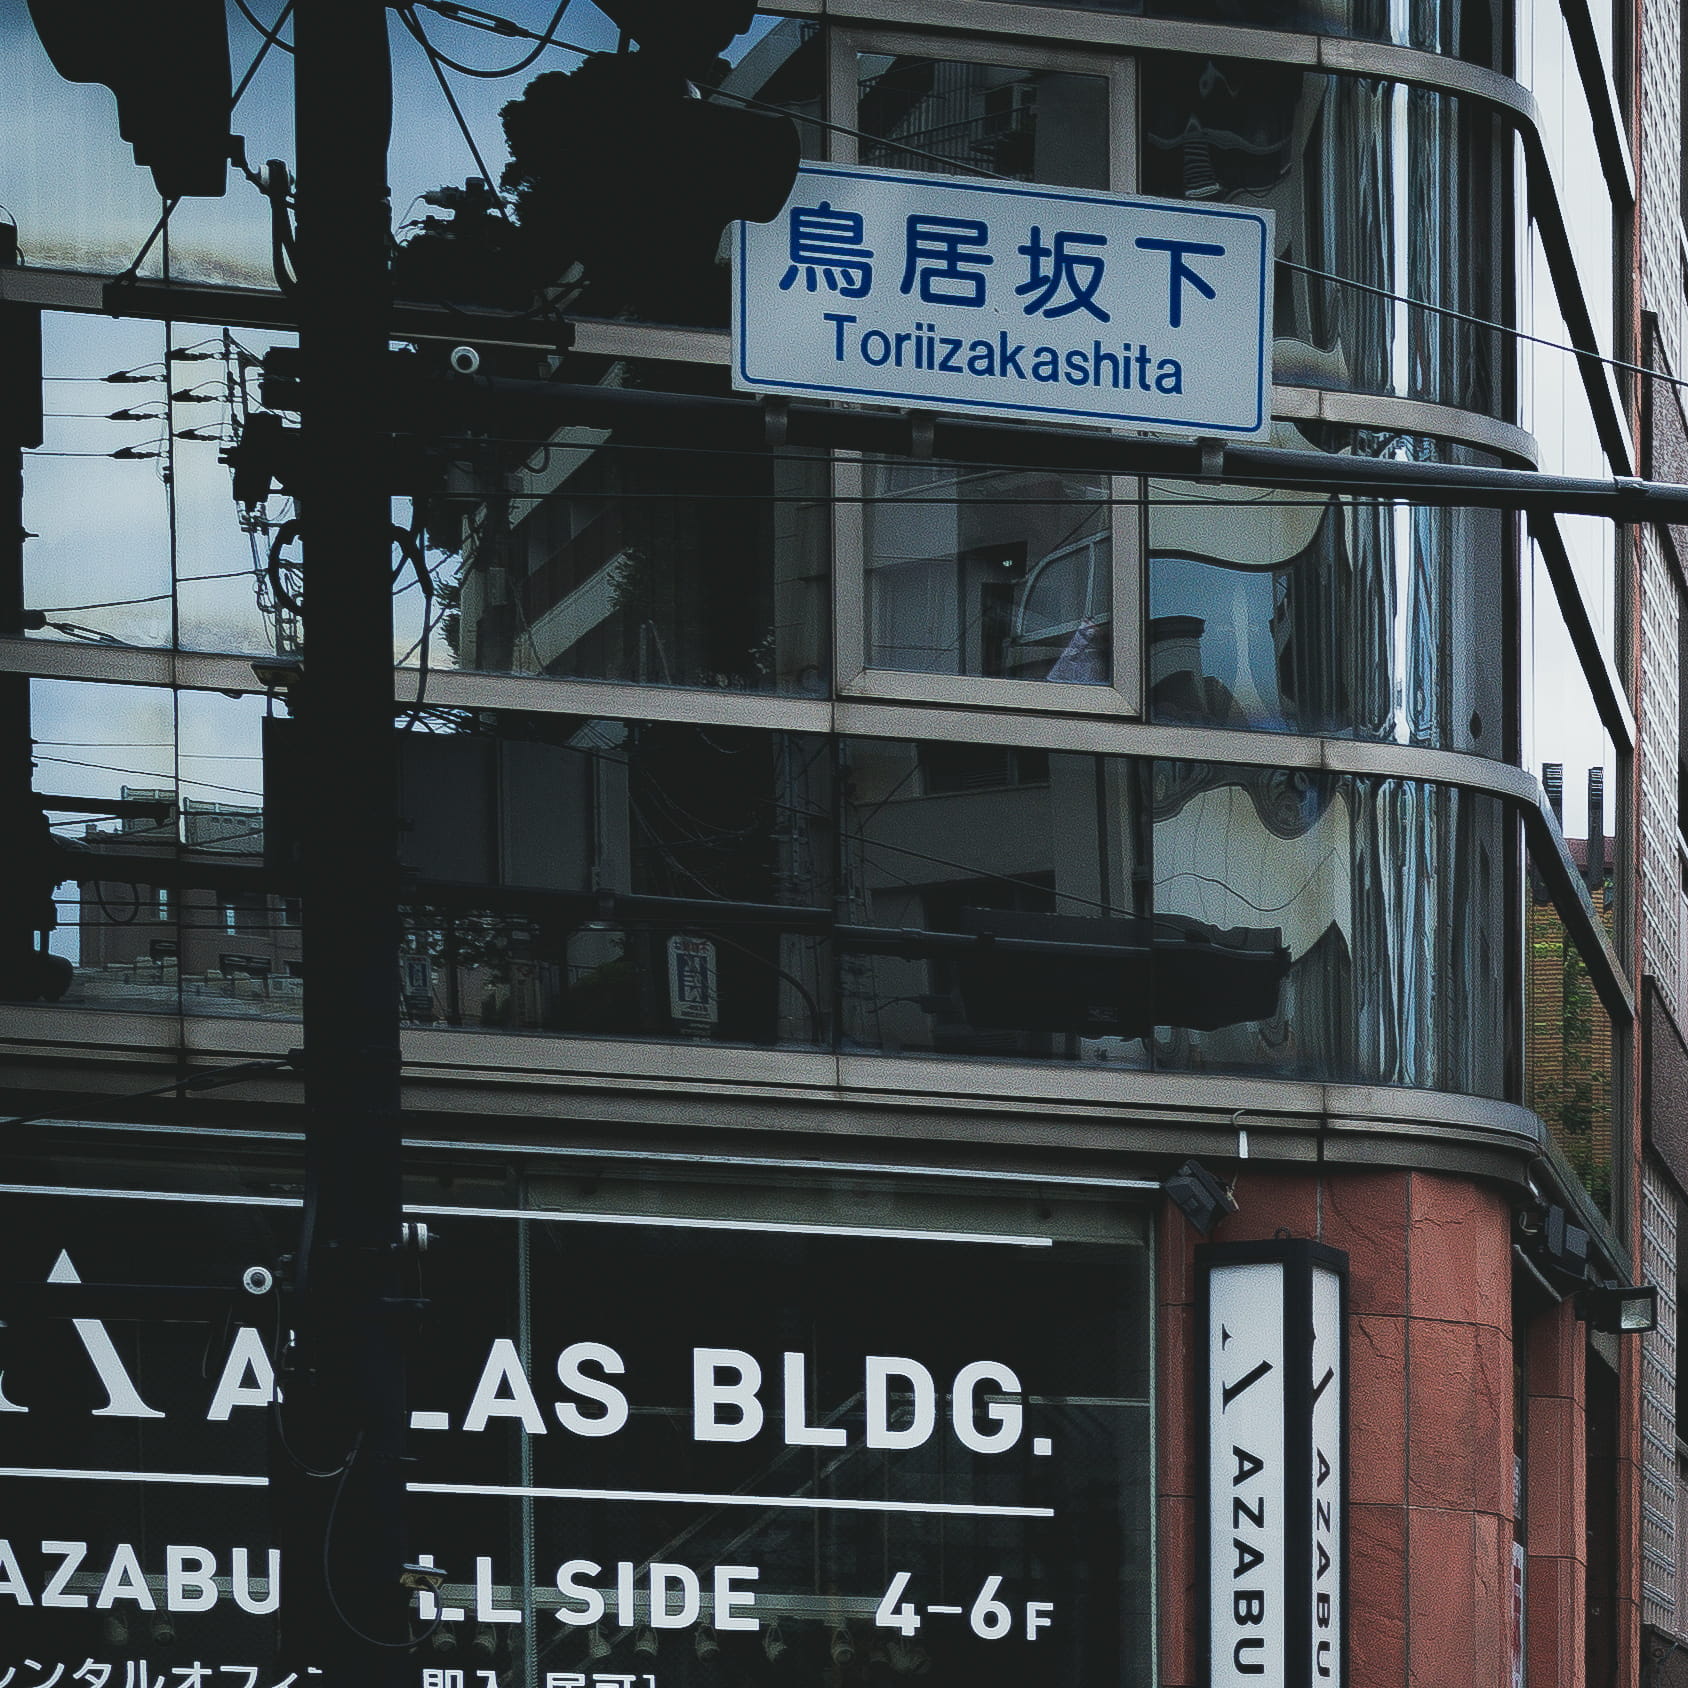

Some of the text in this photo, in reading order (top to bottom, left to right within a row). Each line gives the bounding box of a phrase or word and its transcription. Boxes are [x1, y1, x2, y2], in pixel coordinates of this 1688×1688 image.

[779, 202, 1226, 328] 鳥居坂下
[823, 312, 1184, 395] Toriizakashita
[207, 1326, 1053, 1456] AAS BLDG.
[0, 1538, 281, 1615] AZABU
[554, 1558, 761, 1632] SIDE
[1230, 1443, 1267, 1677] AZABU
[1315, 1445, 1332, 1679] AZABU
